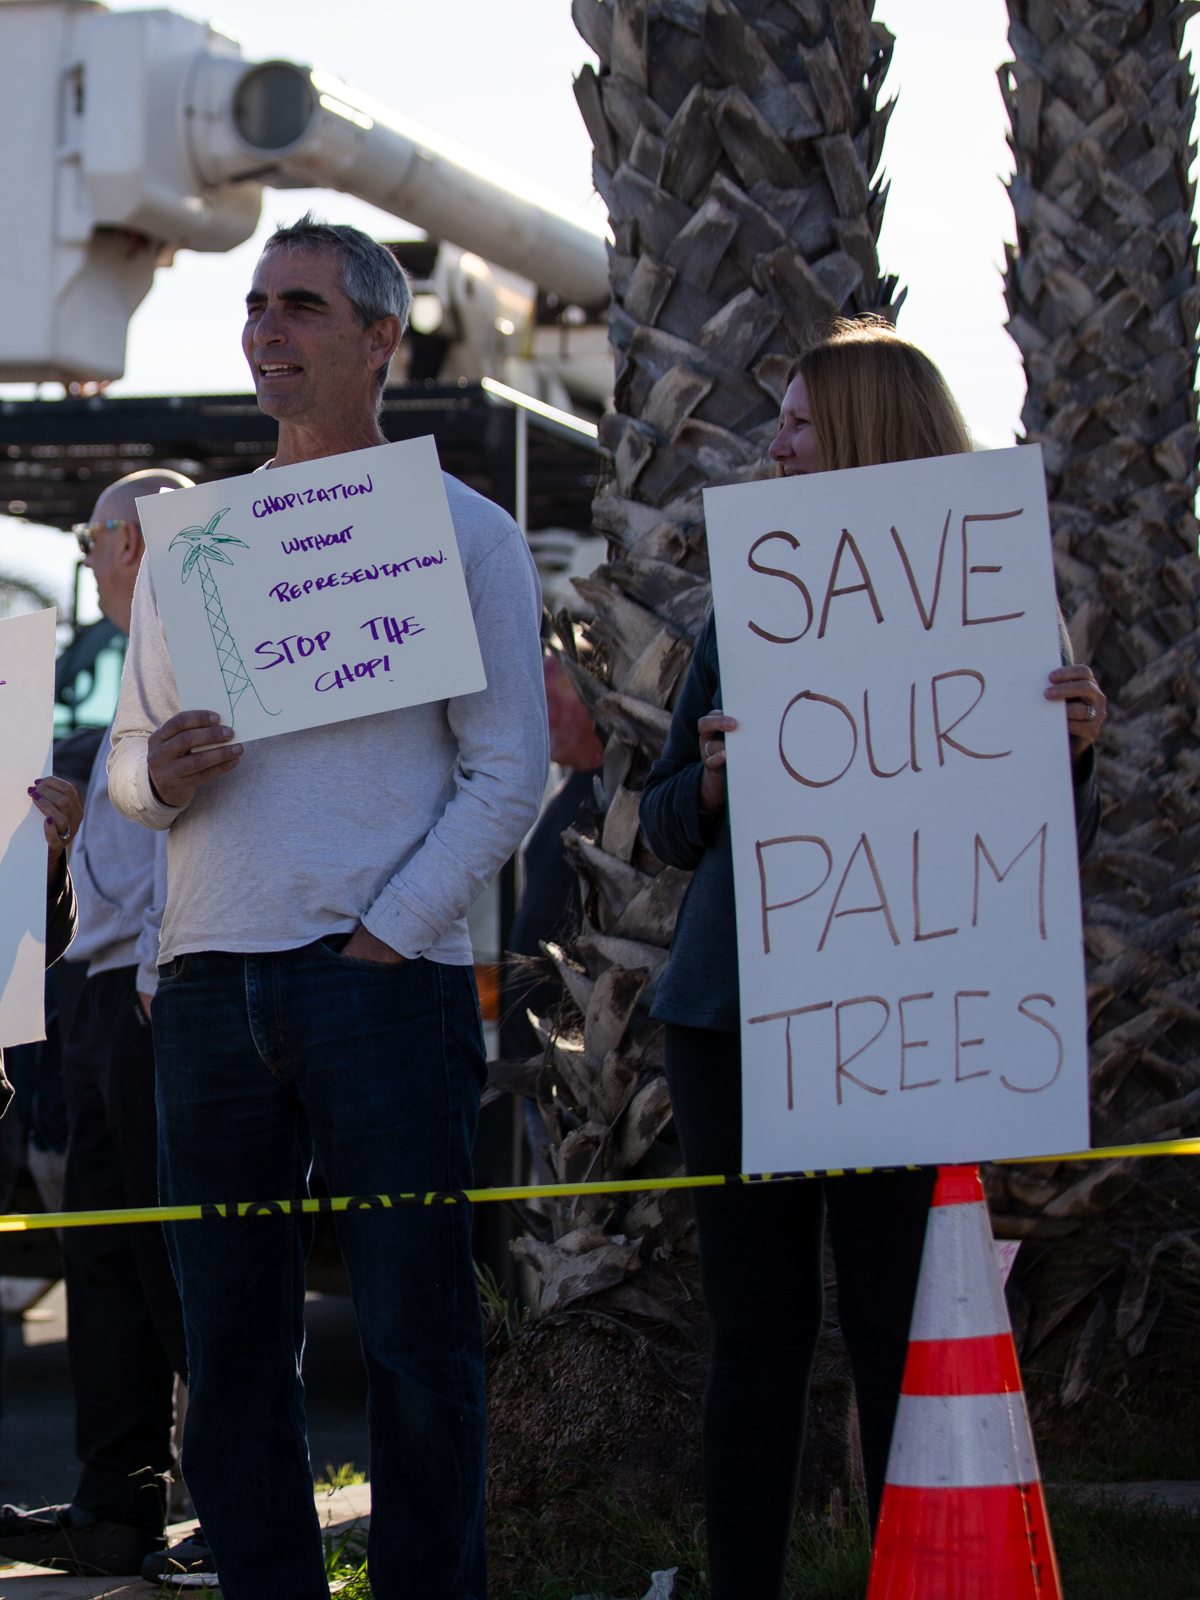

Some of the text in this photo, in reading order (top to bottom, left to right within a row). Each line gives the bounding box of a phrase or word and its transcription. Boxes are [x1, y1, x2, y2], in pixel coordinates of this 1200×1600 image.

[252, 474, 373, 518] CHOPIZATION
[281, 526, 354, 555] WITHOUT
[747, 508, 1026, 645] SAVE
[254, 616, 426, 671] STOP THE
[314, 655, 395, 692] CHOP!
[778, 669, 1013, 789] OUR
[755, 821, 1047, 955] PALM
[746, 990, 1064, 1111] TREES
